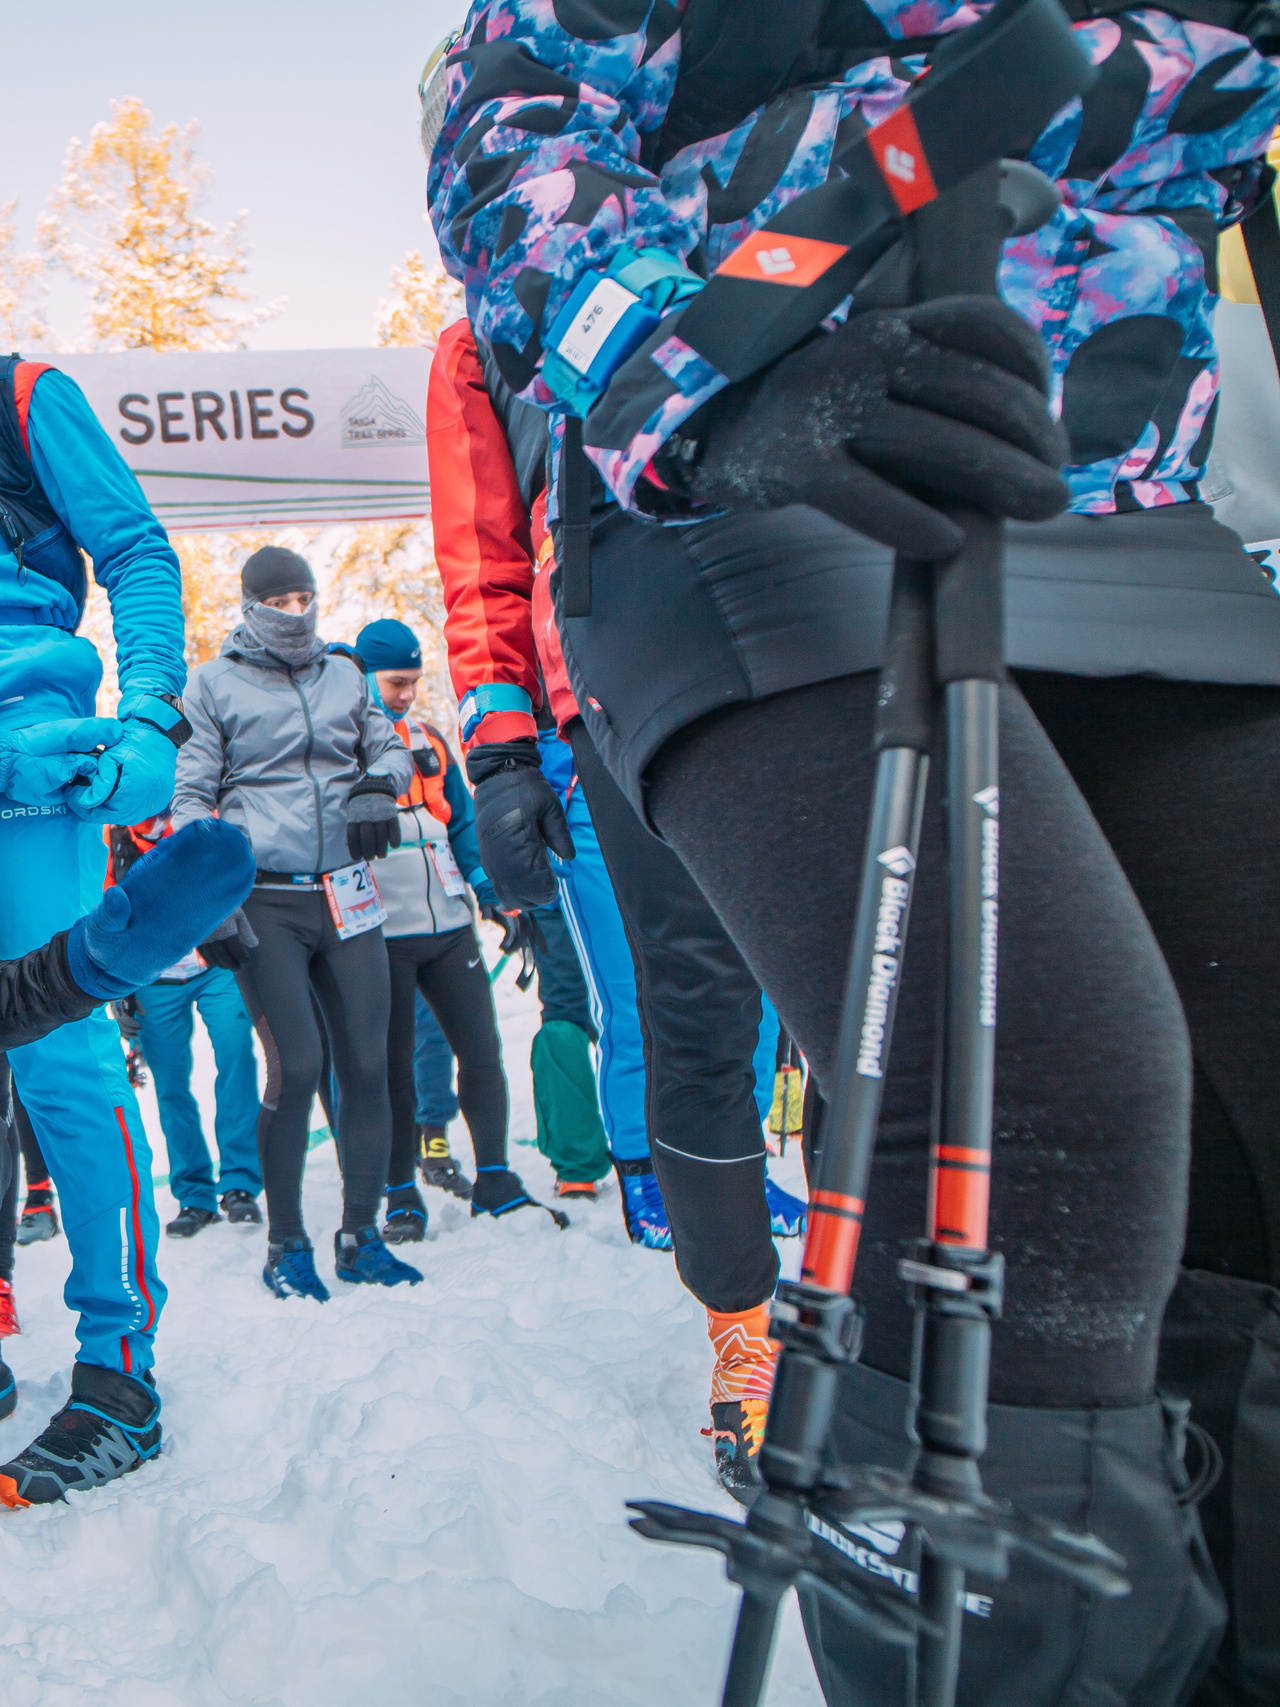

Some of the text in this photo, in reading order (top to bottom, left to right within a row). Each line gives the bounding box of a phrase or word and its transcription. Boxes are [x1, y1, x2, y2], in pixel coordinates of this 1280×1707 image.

[582, 305, 604, 334] 476
[118, 387, 315, 446] SERIES
[856, 876, 910, 1080] Black Diamond
